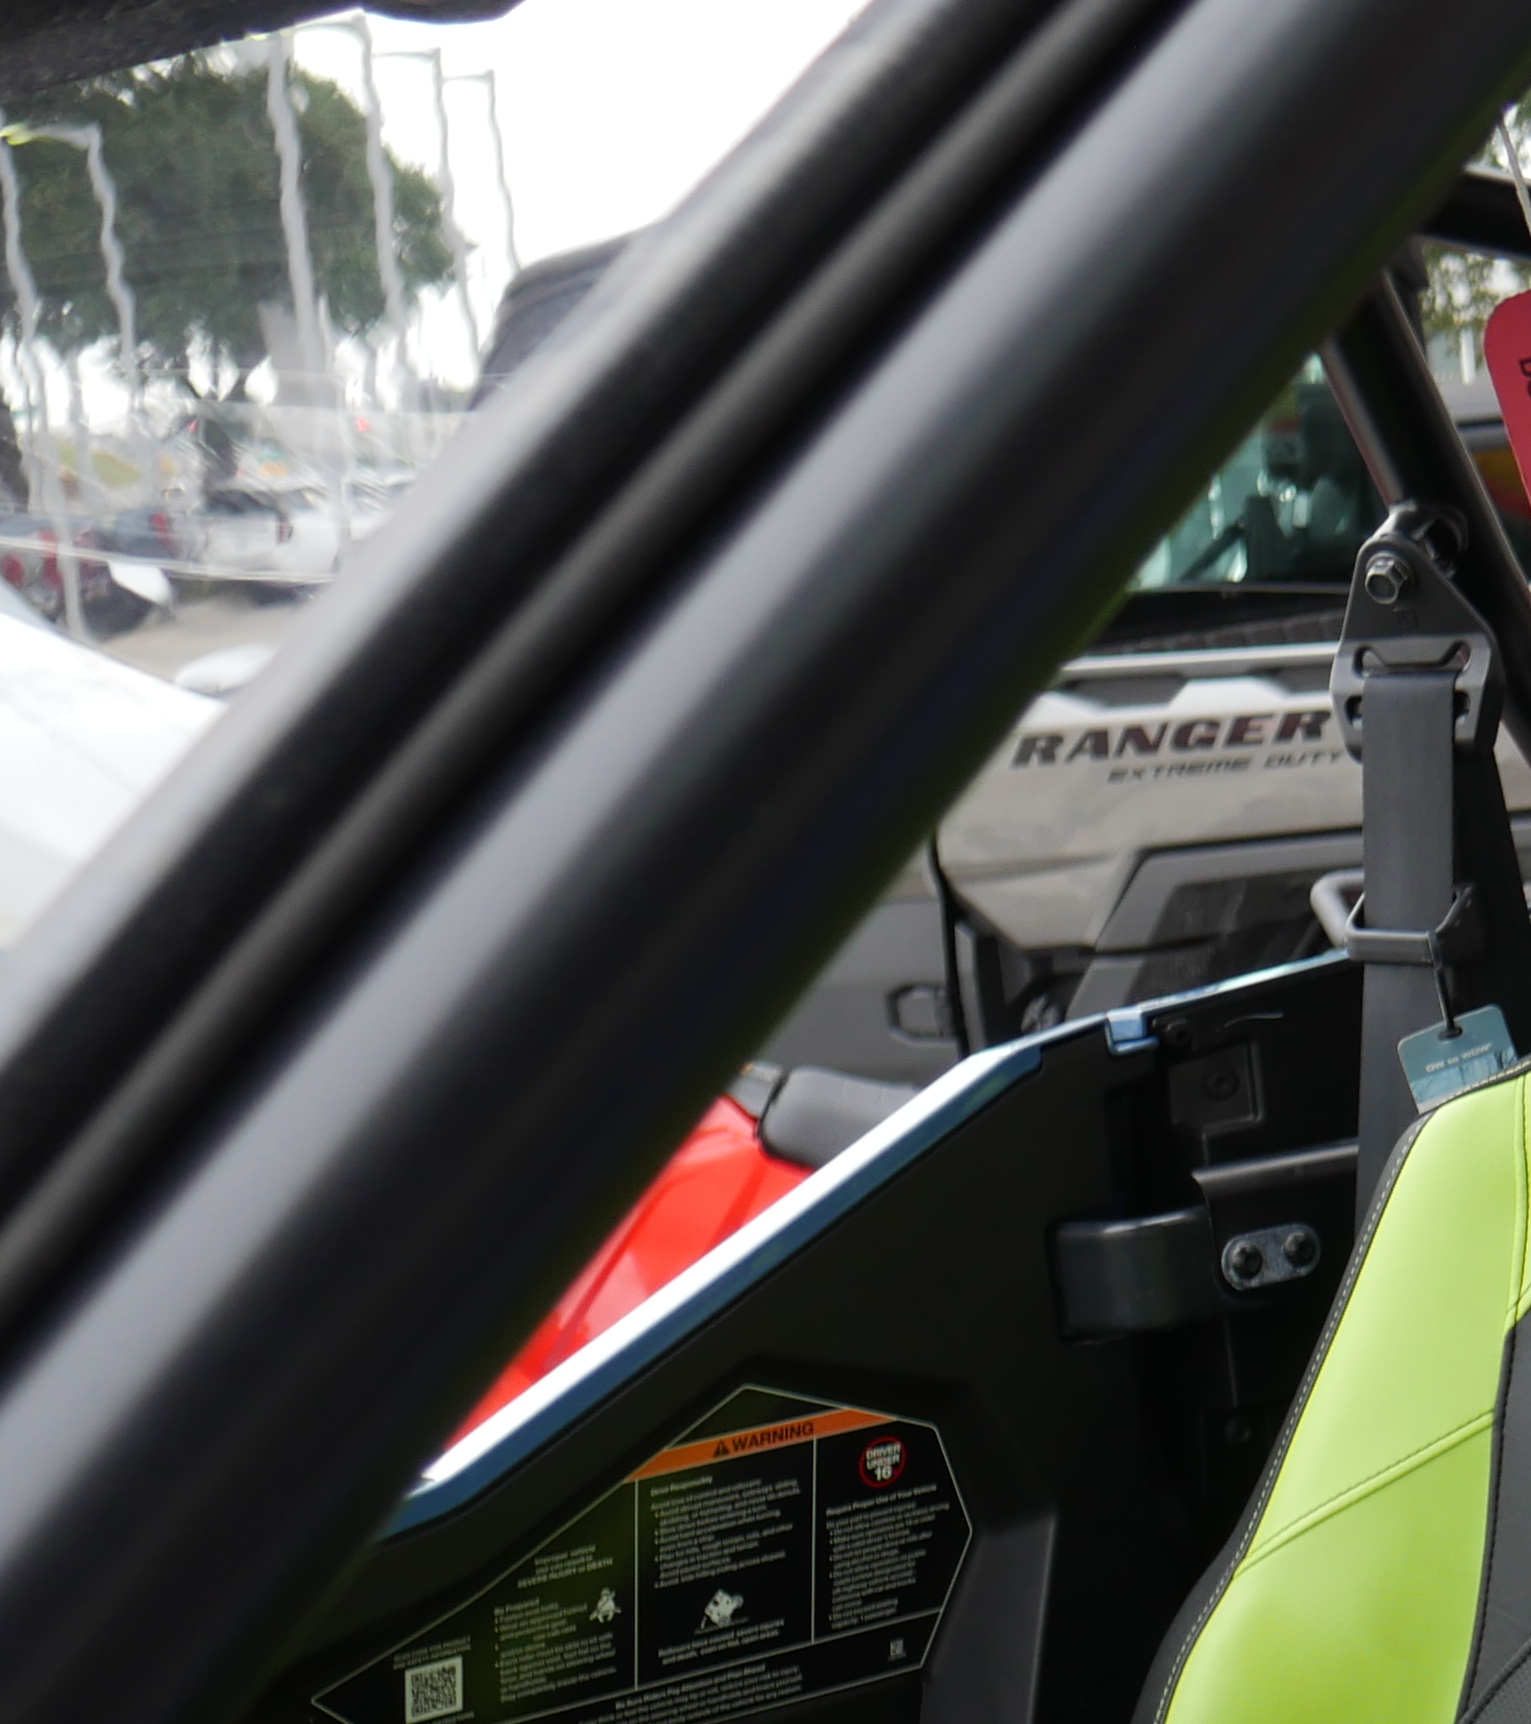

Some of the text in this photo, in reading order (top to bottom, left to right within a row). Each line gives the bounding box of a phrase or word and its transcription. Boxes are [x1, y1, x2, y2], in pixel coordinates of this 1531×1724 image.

[1011, 710, 1331, 767] RANGER
[1107, 750, 1343, 783] EXTREME DUTY
[731, 1421, 814, 1452] WARNING
[874, 1466, 892, 1481] 16
